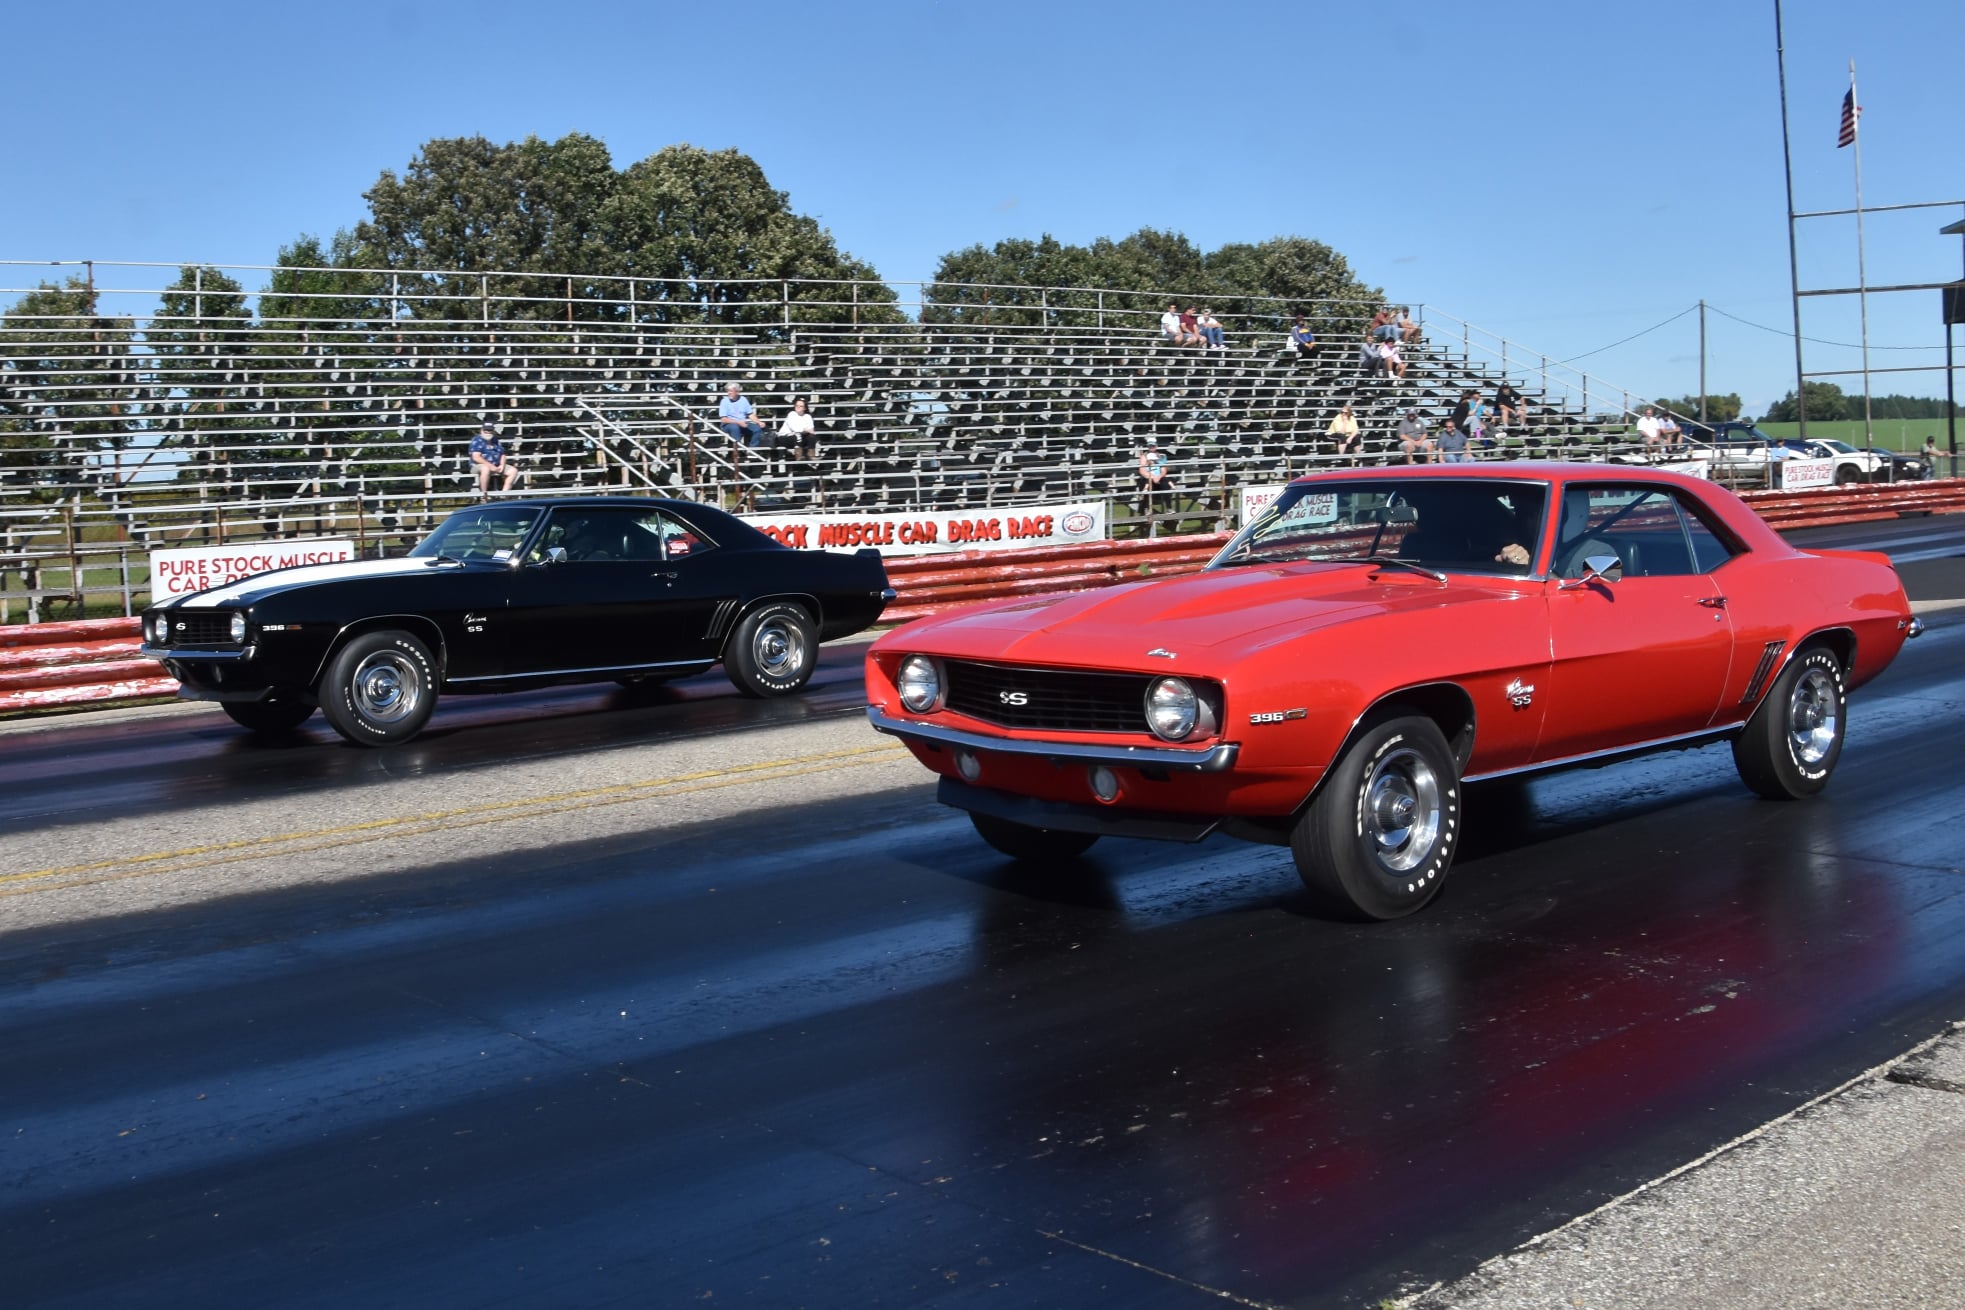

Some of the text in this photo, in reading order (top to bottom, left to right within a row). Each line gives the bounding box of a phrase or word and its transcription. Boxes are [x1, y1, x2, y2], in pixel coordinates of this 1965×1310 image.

[1246, 494, 1268, 506] PURE
[1309, 505, 1331, 518] RACE
[818, 521, 894, 548] MUSCLE
[898, 519, 938, 544] CAR
[947, 517, 1002, 543] DRAG
[1007, 515, 1054, 539] RACE
[159, 551, 348, 577] PURE STOCK MUSCLE
[167, 576, 211, 593] CAR
[467, 625, 484, 633] SS
[999, 691, 1028, 706] SS
[1512, 695, 1532, 706] SS
[1249, 711, 1285, 724] 396
